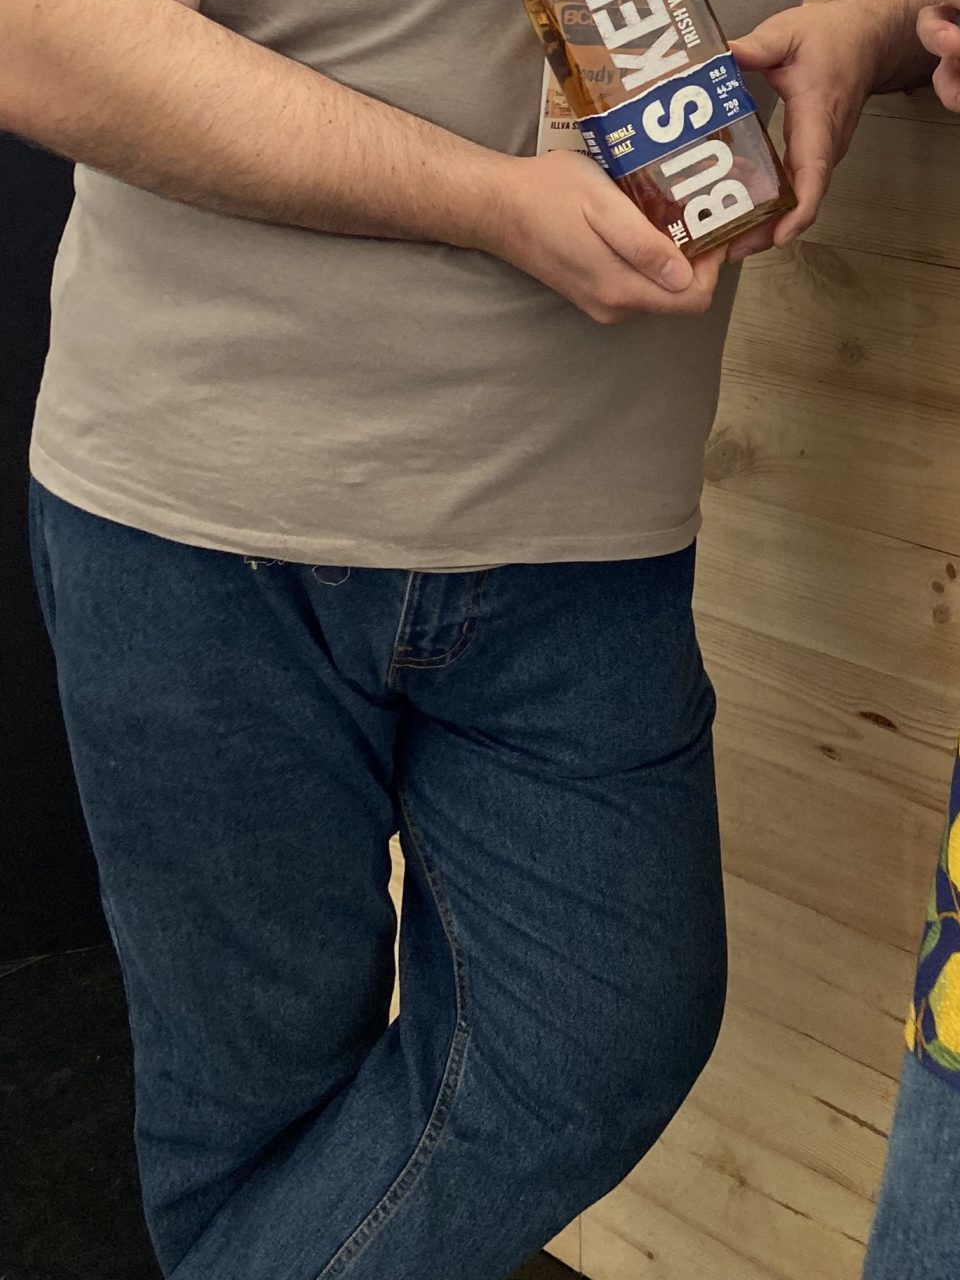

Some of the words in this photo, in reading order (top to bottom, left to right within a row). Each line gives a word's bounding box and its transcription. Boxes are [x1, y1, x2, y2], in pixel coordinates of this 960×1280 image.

[672, 7, 701, 48] IRISH
[723, 98, 739, 111] 700
[605, 123, 635, 144] SINGLE
[611, 140, 633, 158] MALT
[667, 219, 690, 248] THE
